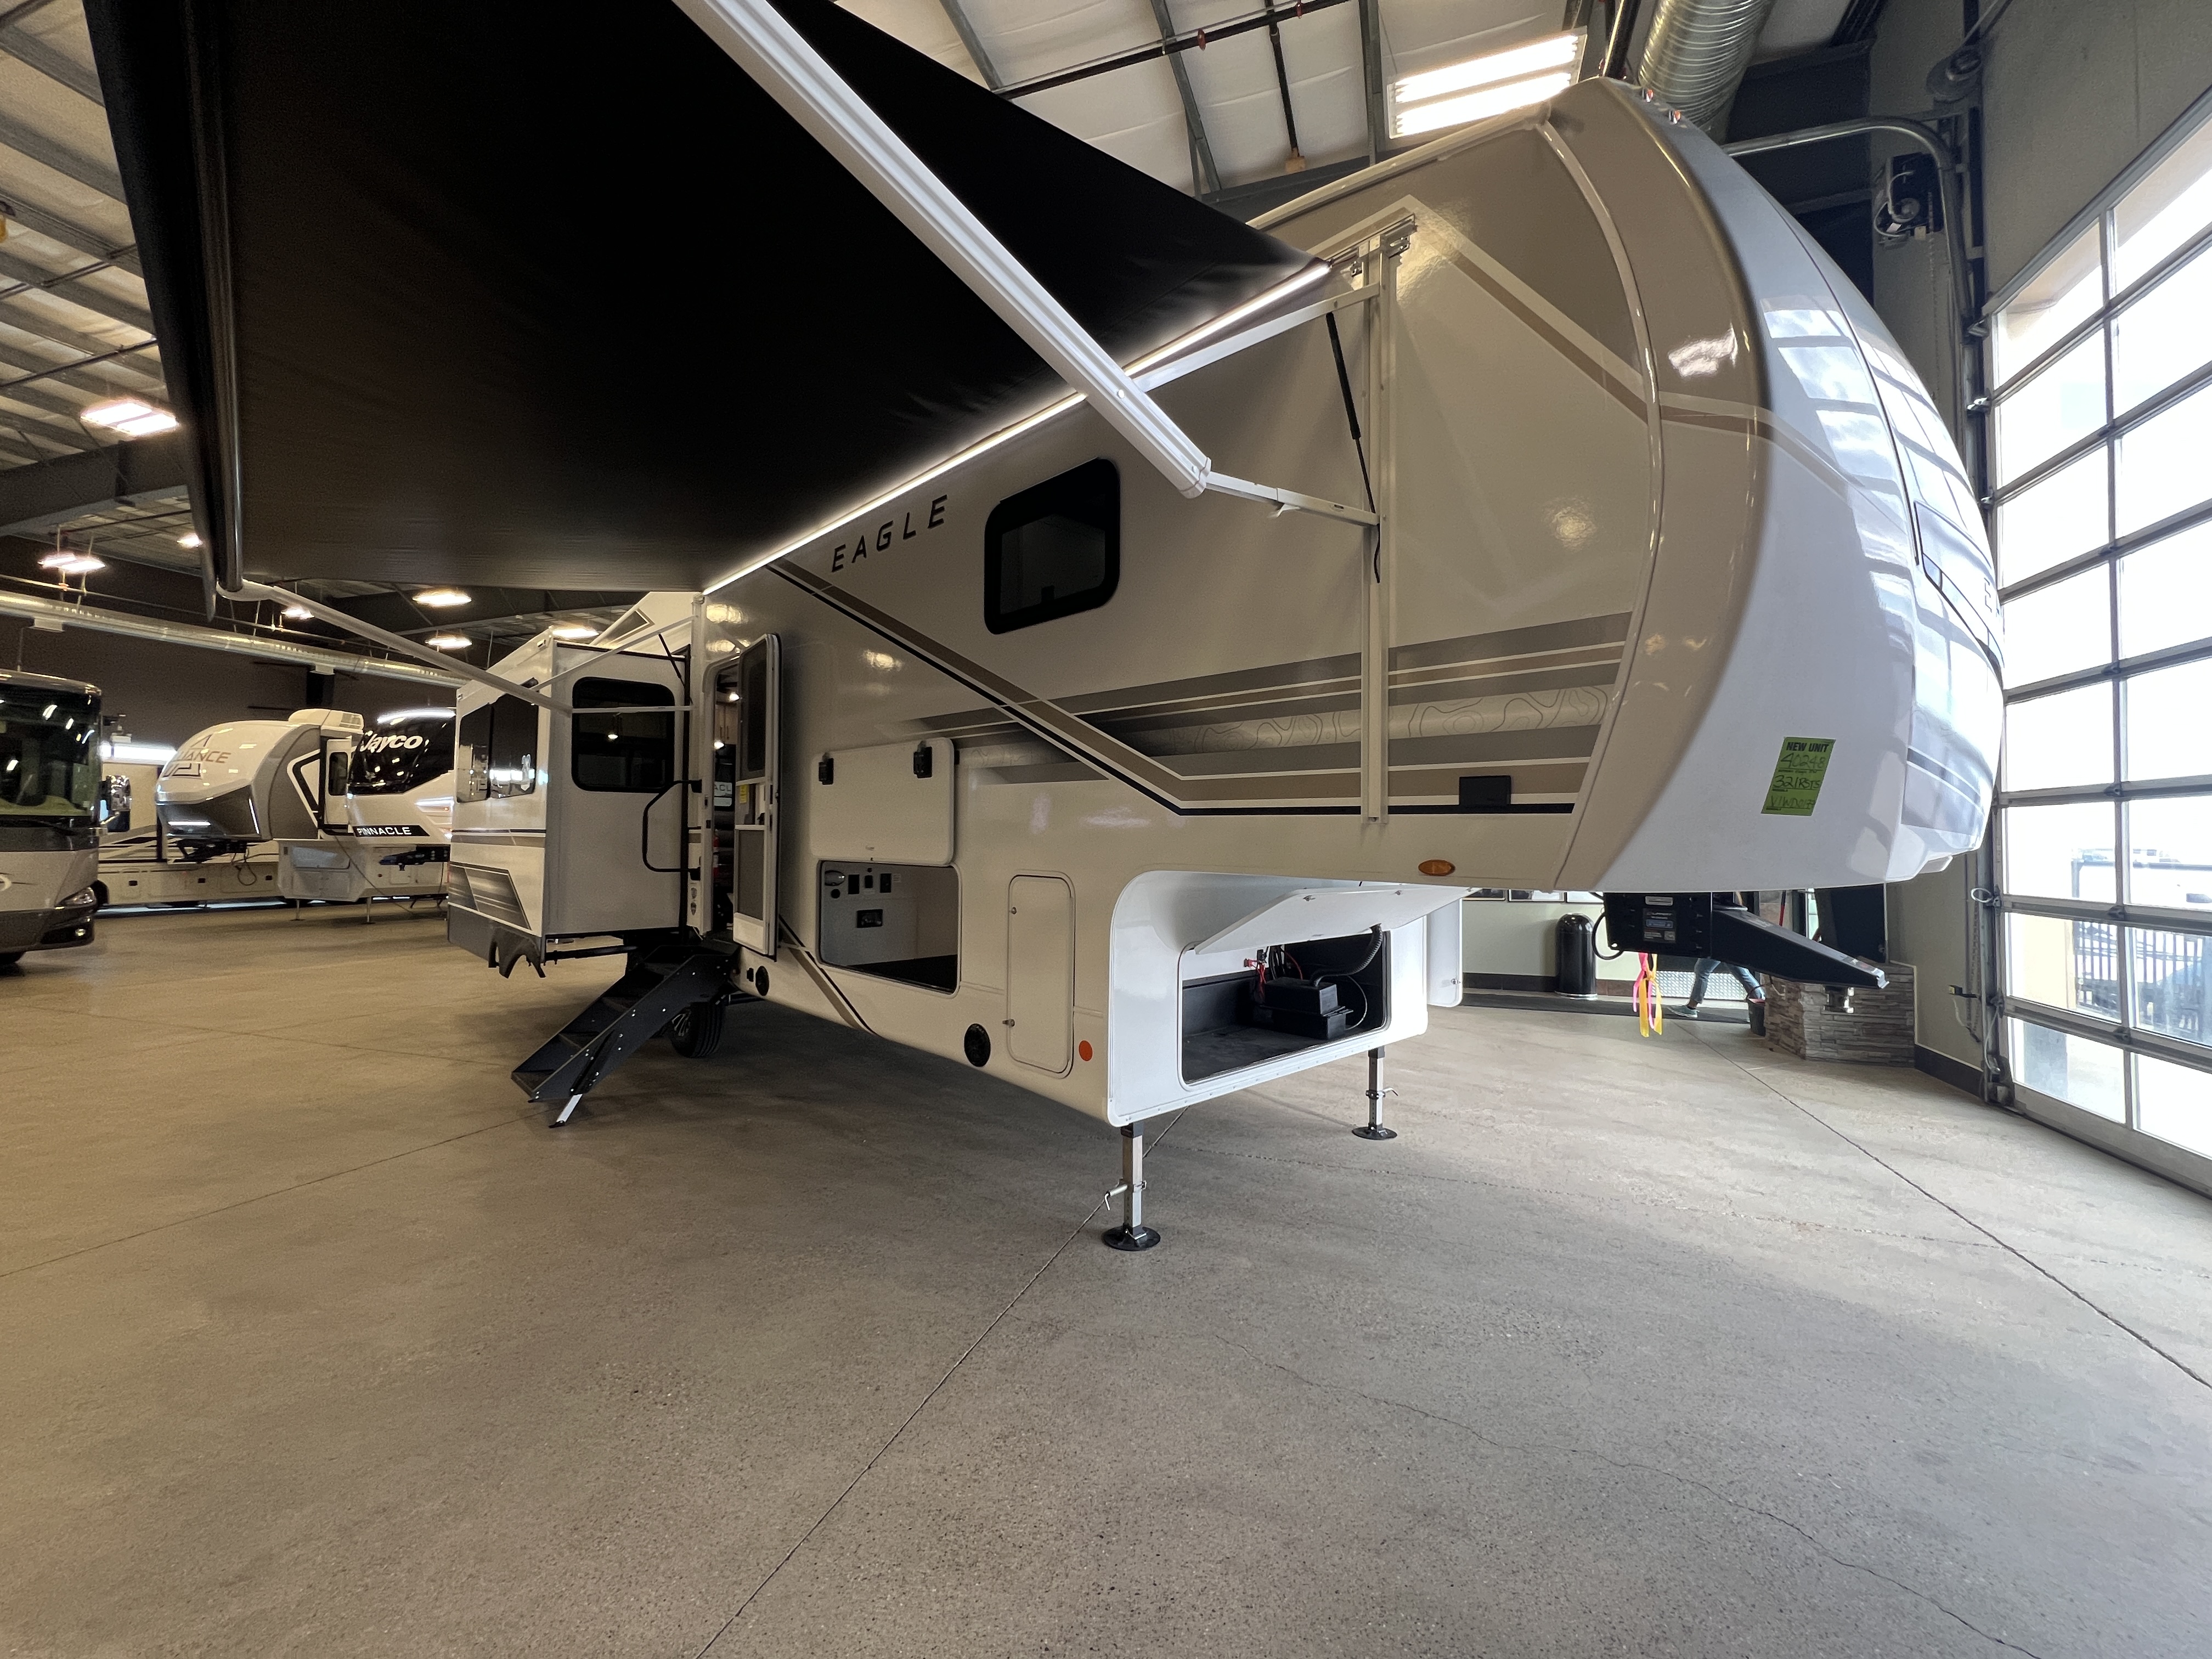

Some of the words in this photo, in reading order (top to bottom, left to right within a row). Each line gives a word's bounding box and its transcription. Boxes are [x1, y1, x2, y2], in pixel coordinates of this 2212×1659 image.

[832, 494, 948, 573] EAGLE
[359, 733, 423, 753] Jayco
[1786, 742, 1807, 752] NEW
[1808, 743, 1829, 753] UNIT
[1780, 752, 1826, 769] 40248
[357, 827, 412, 836] PINNACLE
